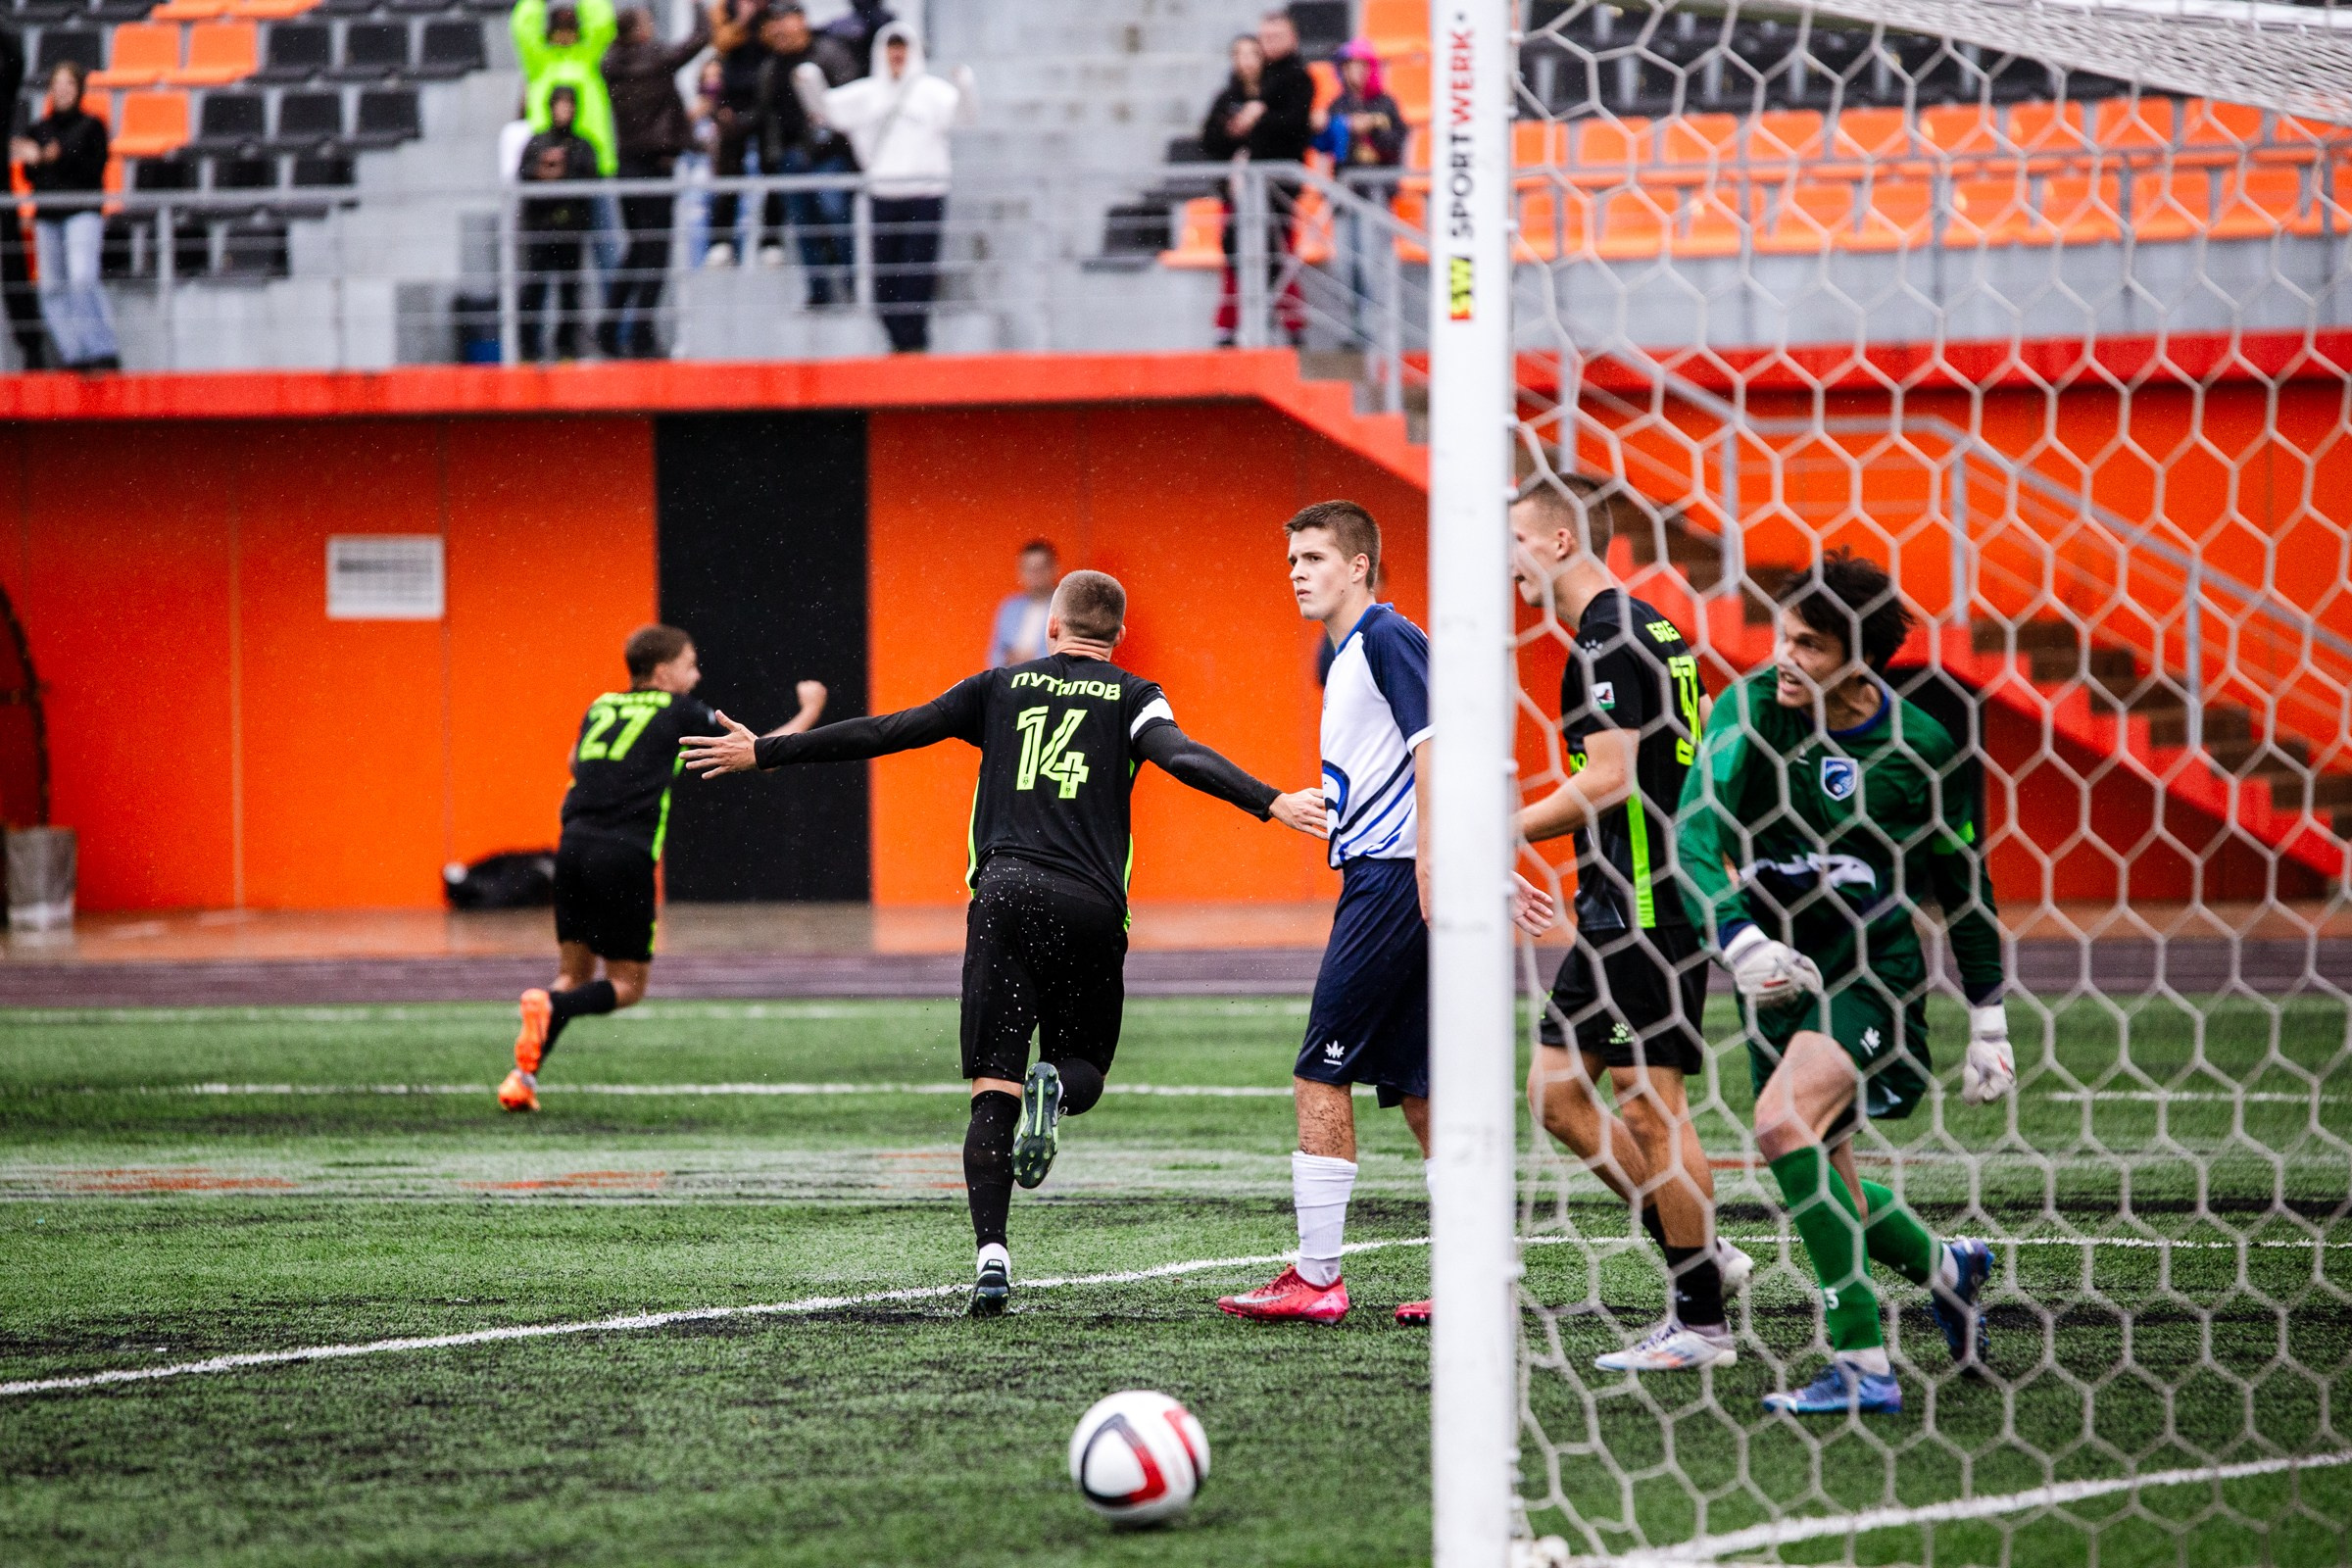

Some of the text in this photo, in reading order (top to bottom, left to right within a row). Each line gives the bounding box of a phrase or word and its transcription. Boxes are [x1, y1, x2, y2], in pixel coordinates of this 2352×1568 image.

[1451, 30, 1473, 238] SPORTWERK
[1010, 672, 1121, 701] ПУТИЛОВ
[578, 705, 659, 761] 27
[1016, 706, 1090, 799] 14
